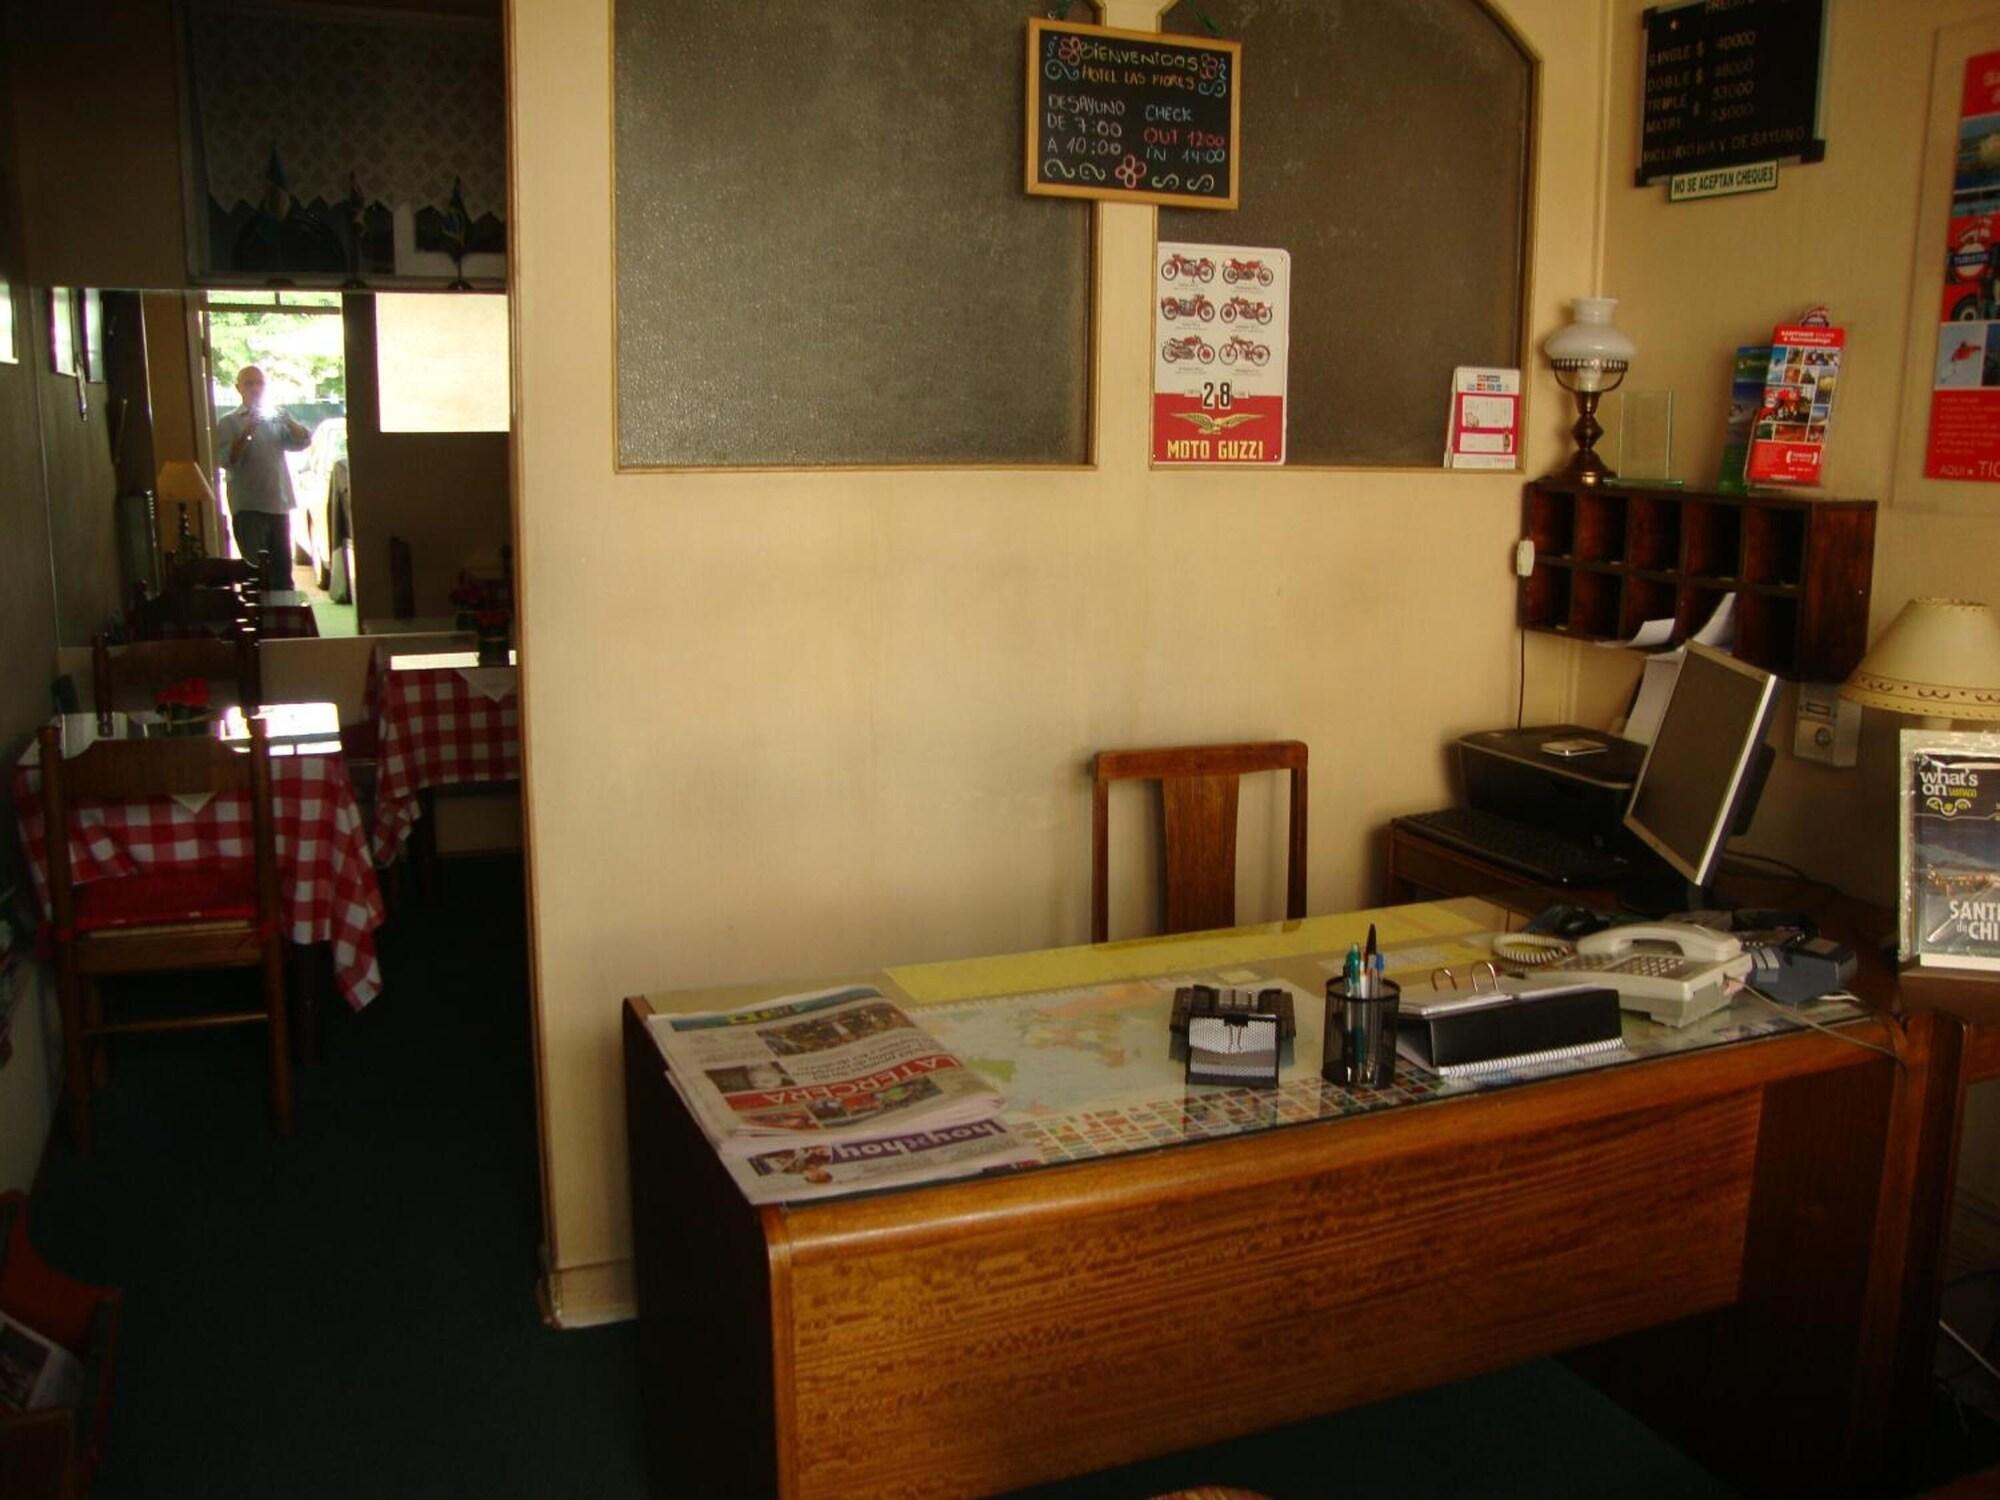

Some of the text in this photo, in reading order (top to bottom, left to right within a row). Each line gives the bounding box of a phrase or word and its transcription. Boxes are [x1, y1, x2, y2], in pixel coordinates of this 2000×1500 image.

[1124, 69, 1147, 86] LAS
[1048, 94, 1125, 116] DESAYUNO
[1144, 105, 1193, 122] CHECK
[1047, 113, 1123, 138] DE 7:00
[1047, 136, 1122, 156] A 10:00
[1143, 127, 1179, 145] OUT
[1674, 166, 1774, 194] NO SE ACEPTAN CHEQUES
[1203, 382, 1231, 407] 28
[1167, 439, 1264, 460] MOTO GUZZI
[1920, 767, 1979, 788] what's
[1922, 784, 1947, 797] on
[1968, 923, 1999, 941] CHI
[920, 1055, 959, 1072] LA
[762, 1063, 913, 1104] TERCERA
